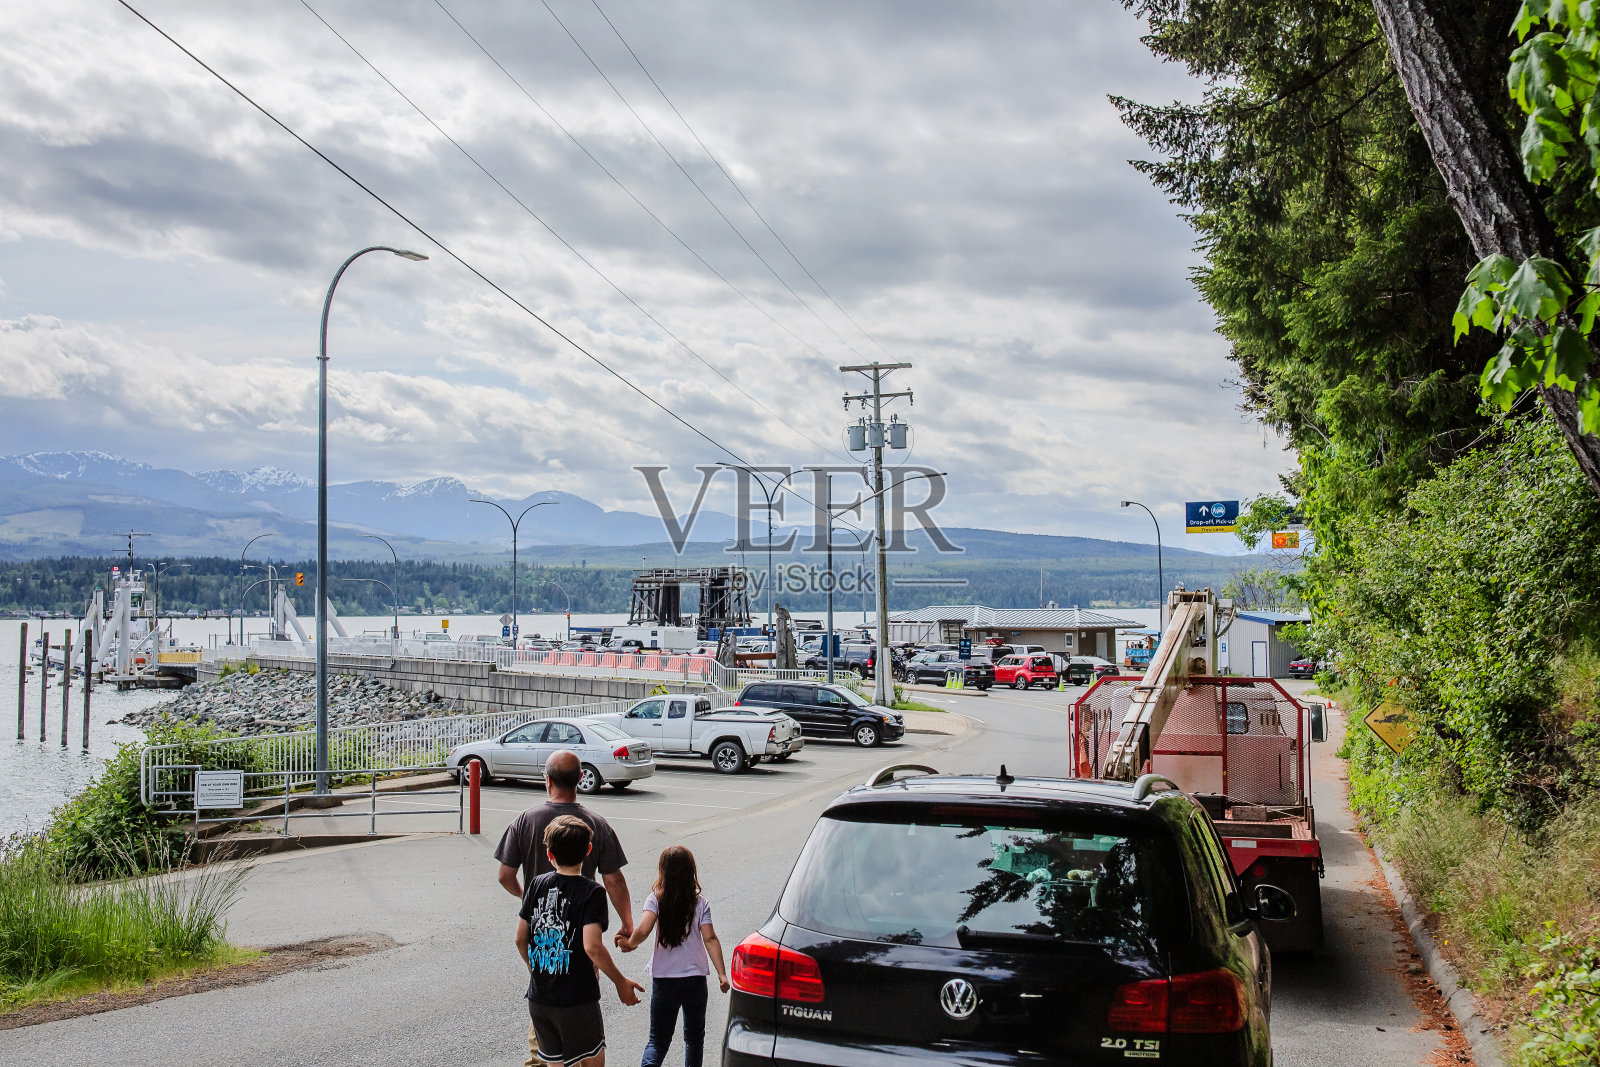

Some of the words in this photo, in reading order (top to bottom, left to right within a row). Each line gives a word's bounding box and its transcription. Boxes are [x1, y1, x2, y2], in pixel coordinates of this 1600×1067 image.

[534, 928, 565, 950] DARK
[528, 943, 573, 975] KNIGHT
[1101, 1037, 1127, 1049] 2.0
[1133, 1039, 1160, 1050] TSI
